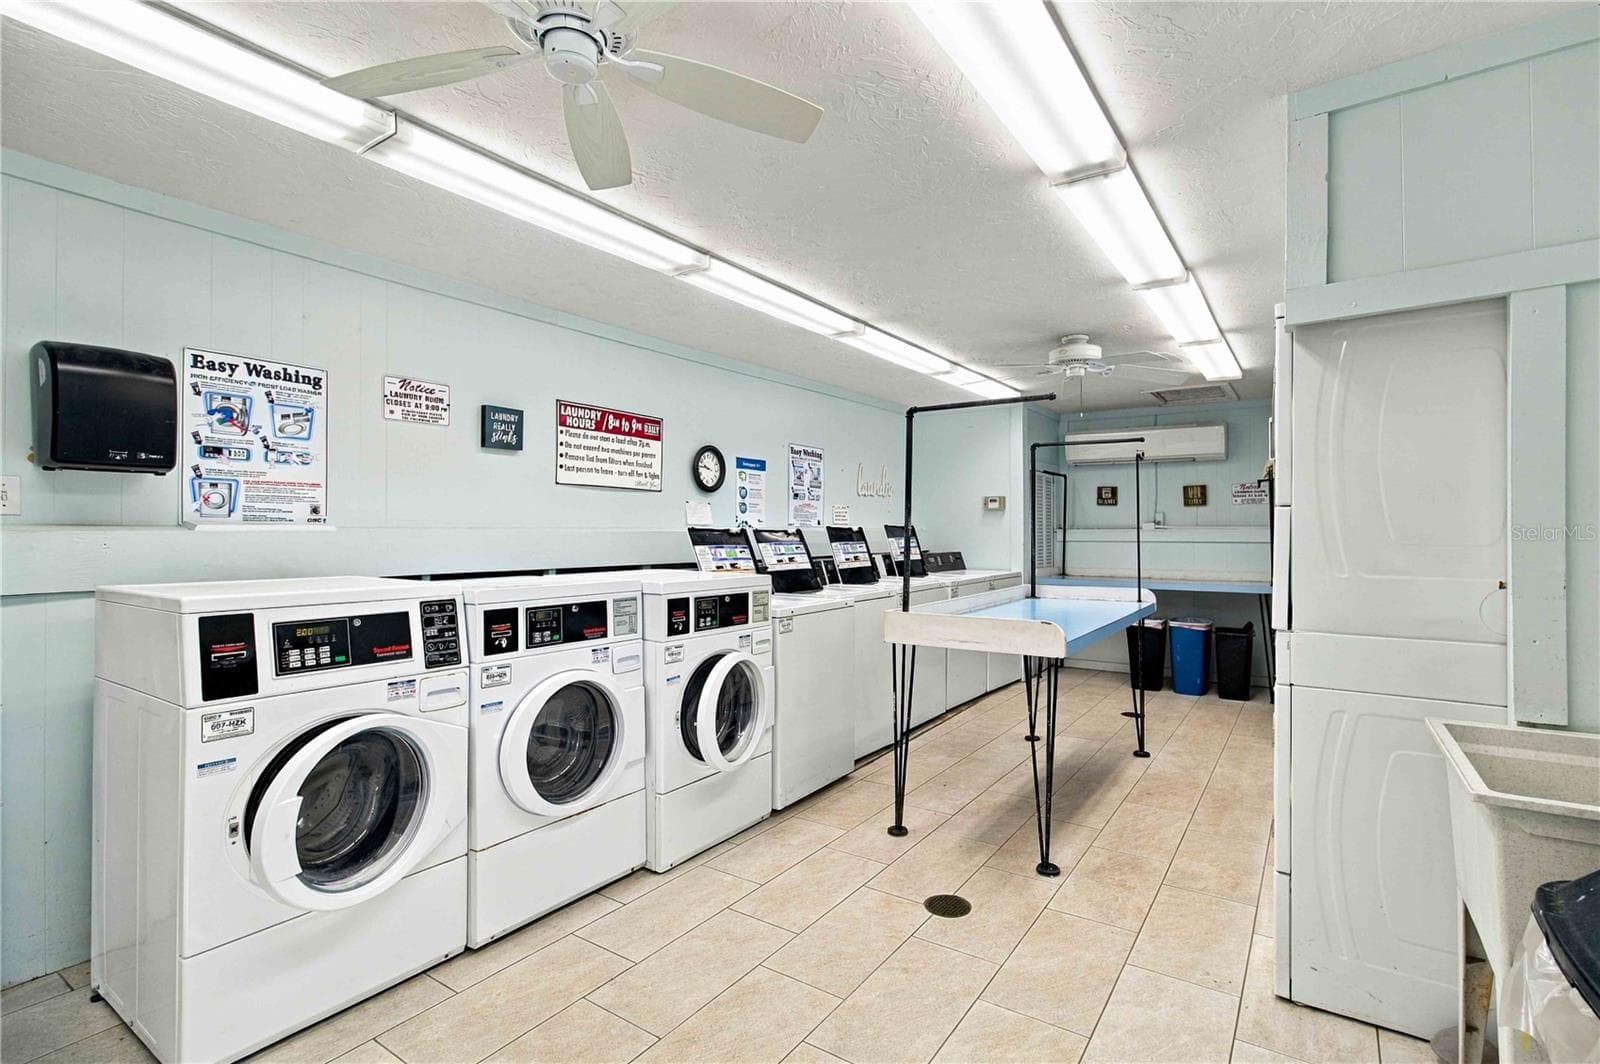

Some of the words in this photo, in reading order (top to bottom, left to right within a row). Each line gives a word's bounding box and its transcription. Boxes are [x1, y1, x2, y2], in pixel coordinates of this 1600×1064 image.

[190, 353, 239, 377] Easy
[243, 362, 323, 390] Washing
[210, 376, 248, 386] EFFICIENCY
[258, 382, 278, 390] FRONT
[398, 379, 436, 394] Notice
[386, 399, 412, 408] CLOSES
[390, 390, 422, 400] LAUNDRY
[425, 396, 444, 404] ROOM
[490, 412, 518, 422] LAUNDRY
[561, 405, 602, 420] LAUNDRY
[622, 418, 630, 432] to
[644, 424, 660, 435] DAILY
[566, 416, 596, 430] HOURS
[493, 422, 516, 431] REALLY
[565, 429, 581, 438] Please
[565, 452, 585, 462] Remove
[611, 448, 632, 456] machines
[790, 446, 802, 457] Easy
[803, 449, 822, 460] Washing
